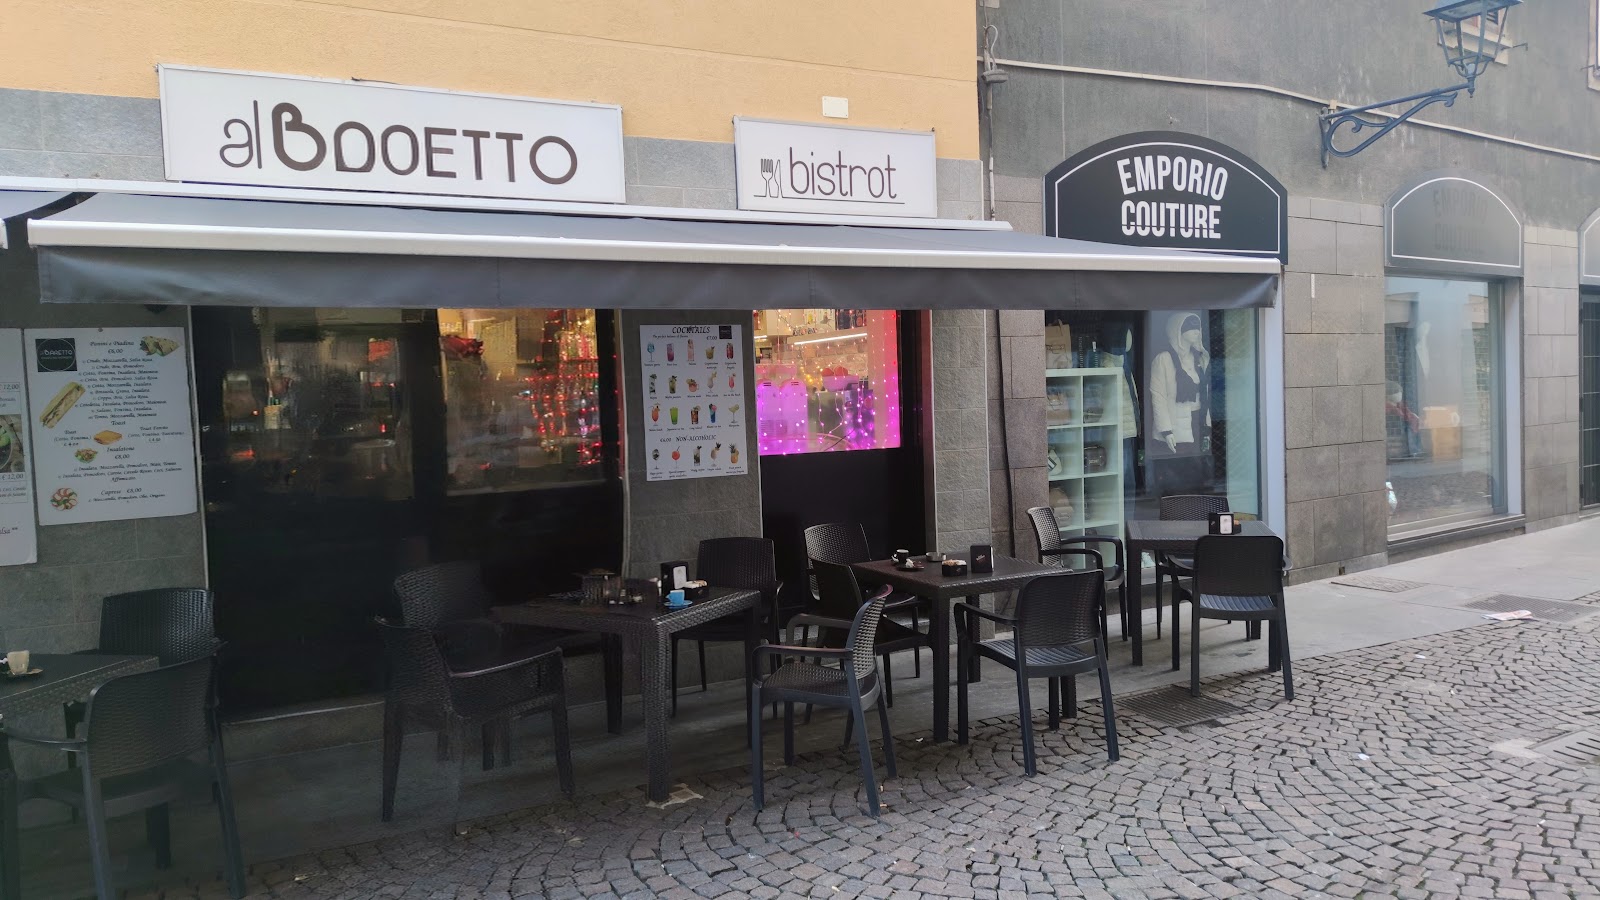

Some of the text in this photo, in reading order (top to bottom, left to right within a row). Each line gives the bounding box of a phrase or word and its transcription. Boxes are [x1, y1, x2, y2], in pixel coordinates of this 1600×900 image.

[788, 146, 897, 199] bistrot
[1116, 154, 1229, 201] EMPORIO
[1121, 199, 1222, 239] COUTURE
[672, 325, 711, 334] COCKTAILS
